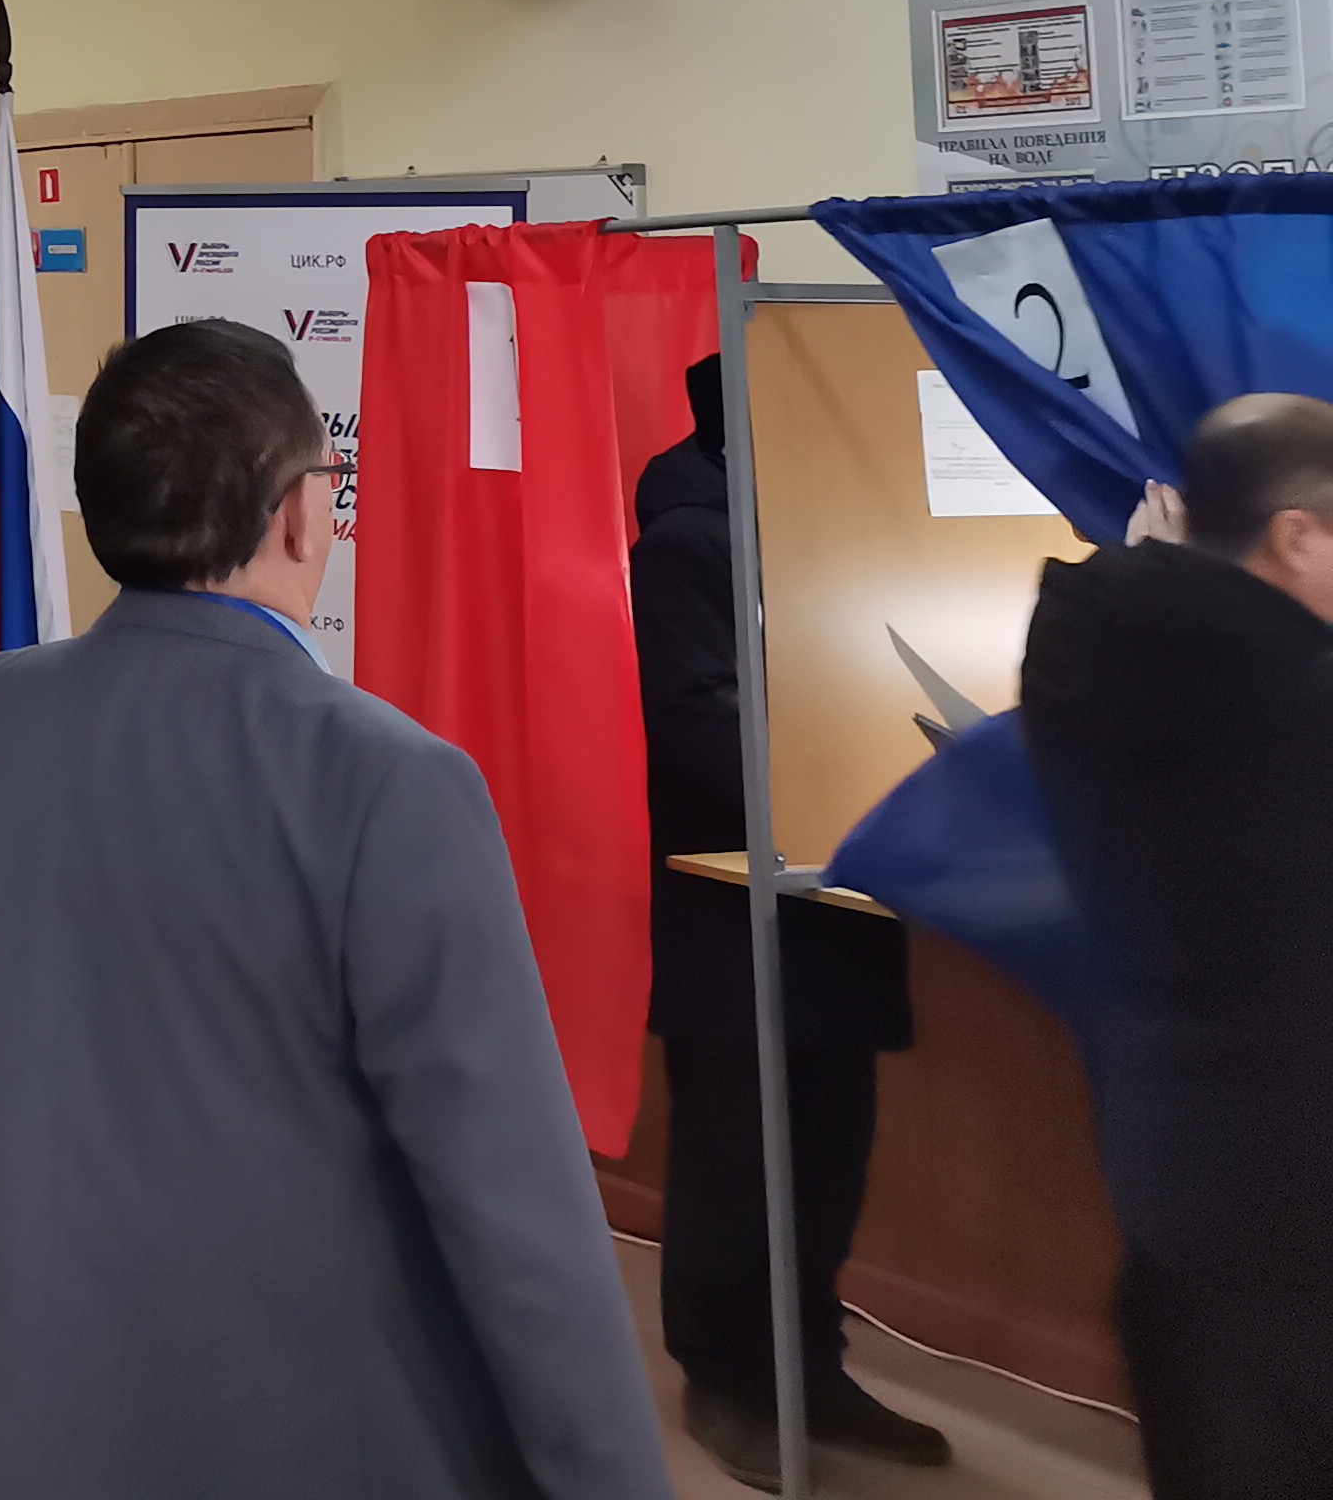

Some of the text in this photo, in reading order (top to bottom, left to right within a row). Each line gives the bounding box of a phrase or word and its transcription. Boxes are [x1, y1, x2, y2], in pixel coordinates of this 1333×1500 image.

[938, 130, 1107, 153] ПРАВИЛА ПОВЕДЕНИЯ
[989, 150, 1055, 166] НА ВОДЕ
[290, 254, 347, 269] ЦИК.РФ
